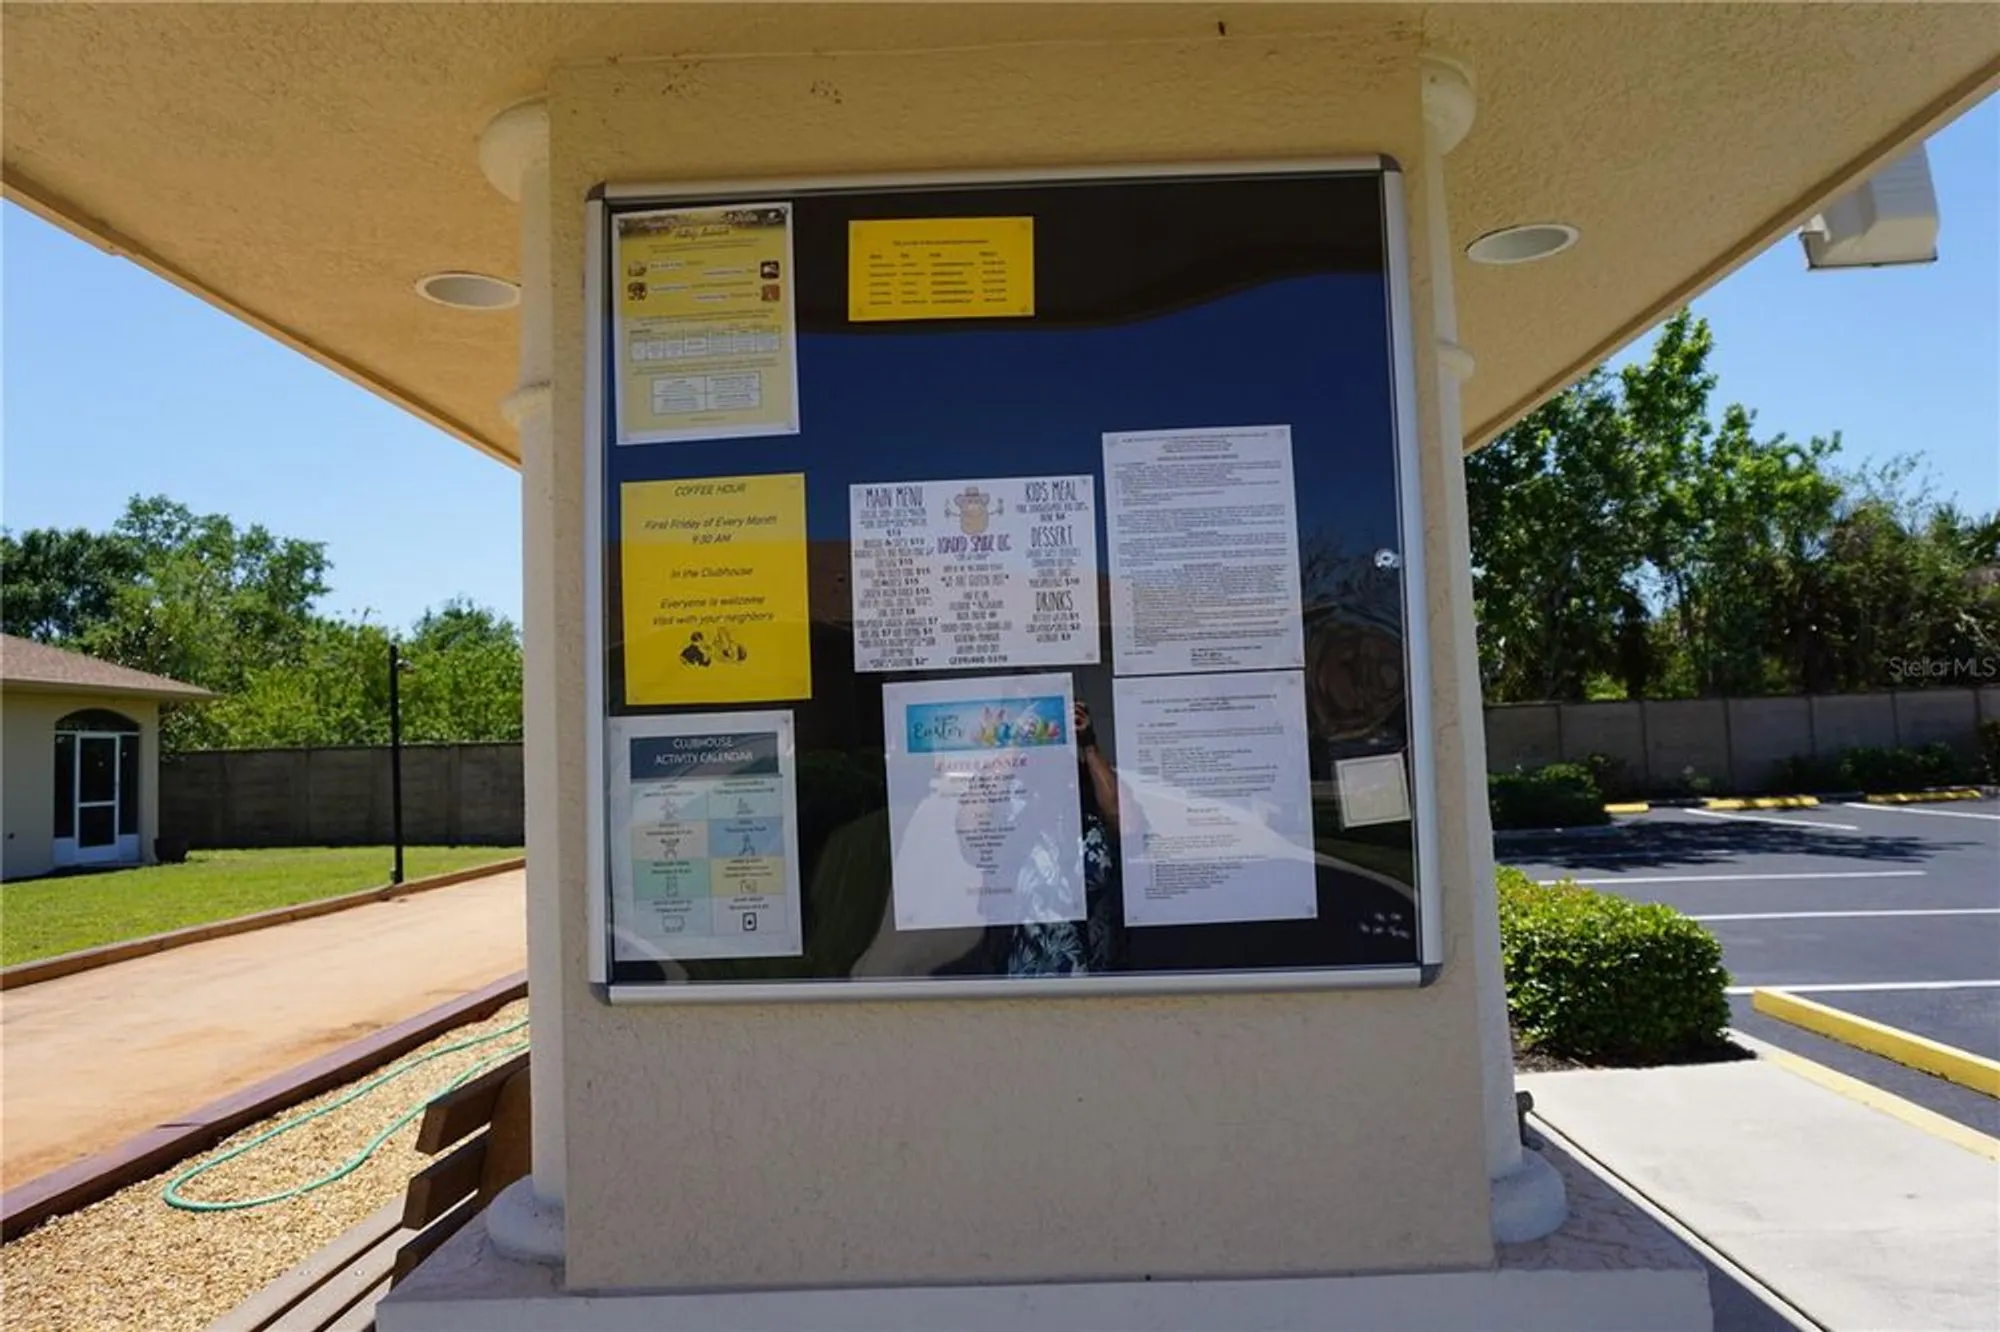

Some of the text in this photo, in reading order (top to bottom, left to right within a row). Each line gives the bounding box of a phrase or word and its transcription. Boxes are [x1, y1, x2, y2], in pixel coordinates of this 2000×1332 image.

[674, 483, 746, 497] COFFEE HOUR
[1052, 480, 1077, 501] MEAL
[644, 515, 777, 530] First Friday of Every Month
[1030, 525, 1073, 548] DESSERT
[700, 567, 753, 578] Clubhouse
[660, 598, 707, 609] Everyone
[720, 596, 765, 606] welcome
[1036, 590, 1073, 611] DRINKS
[676, 615, 698, 625] with
[700, 615, 723, 627] your
[726, 611, 774, 625] neighbors
[913, 718, 964, 742] Easter
[655, 750, 753, 765] ACTIVITY CALENDAR
